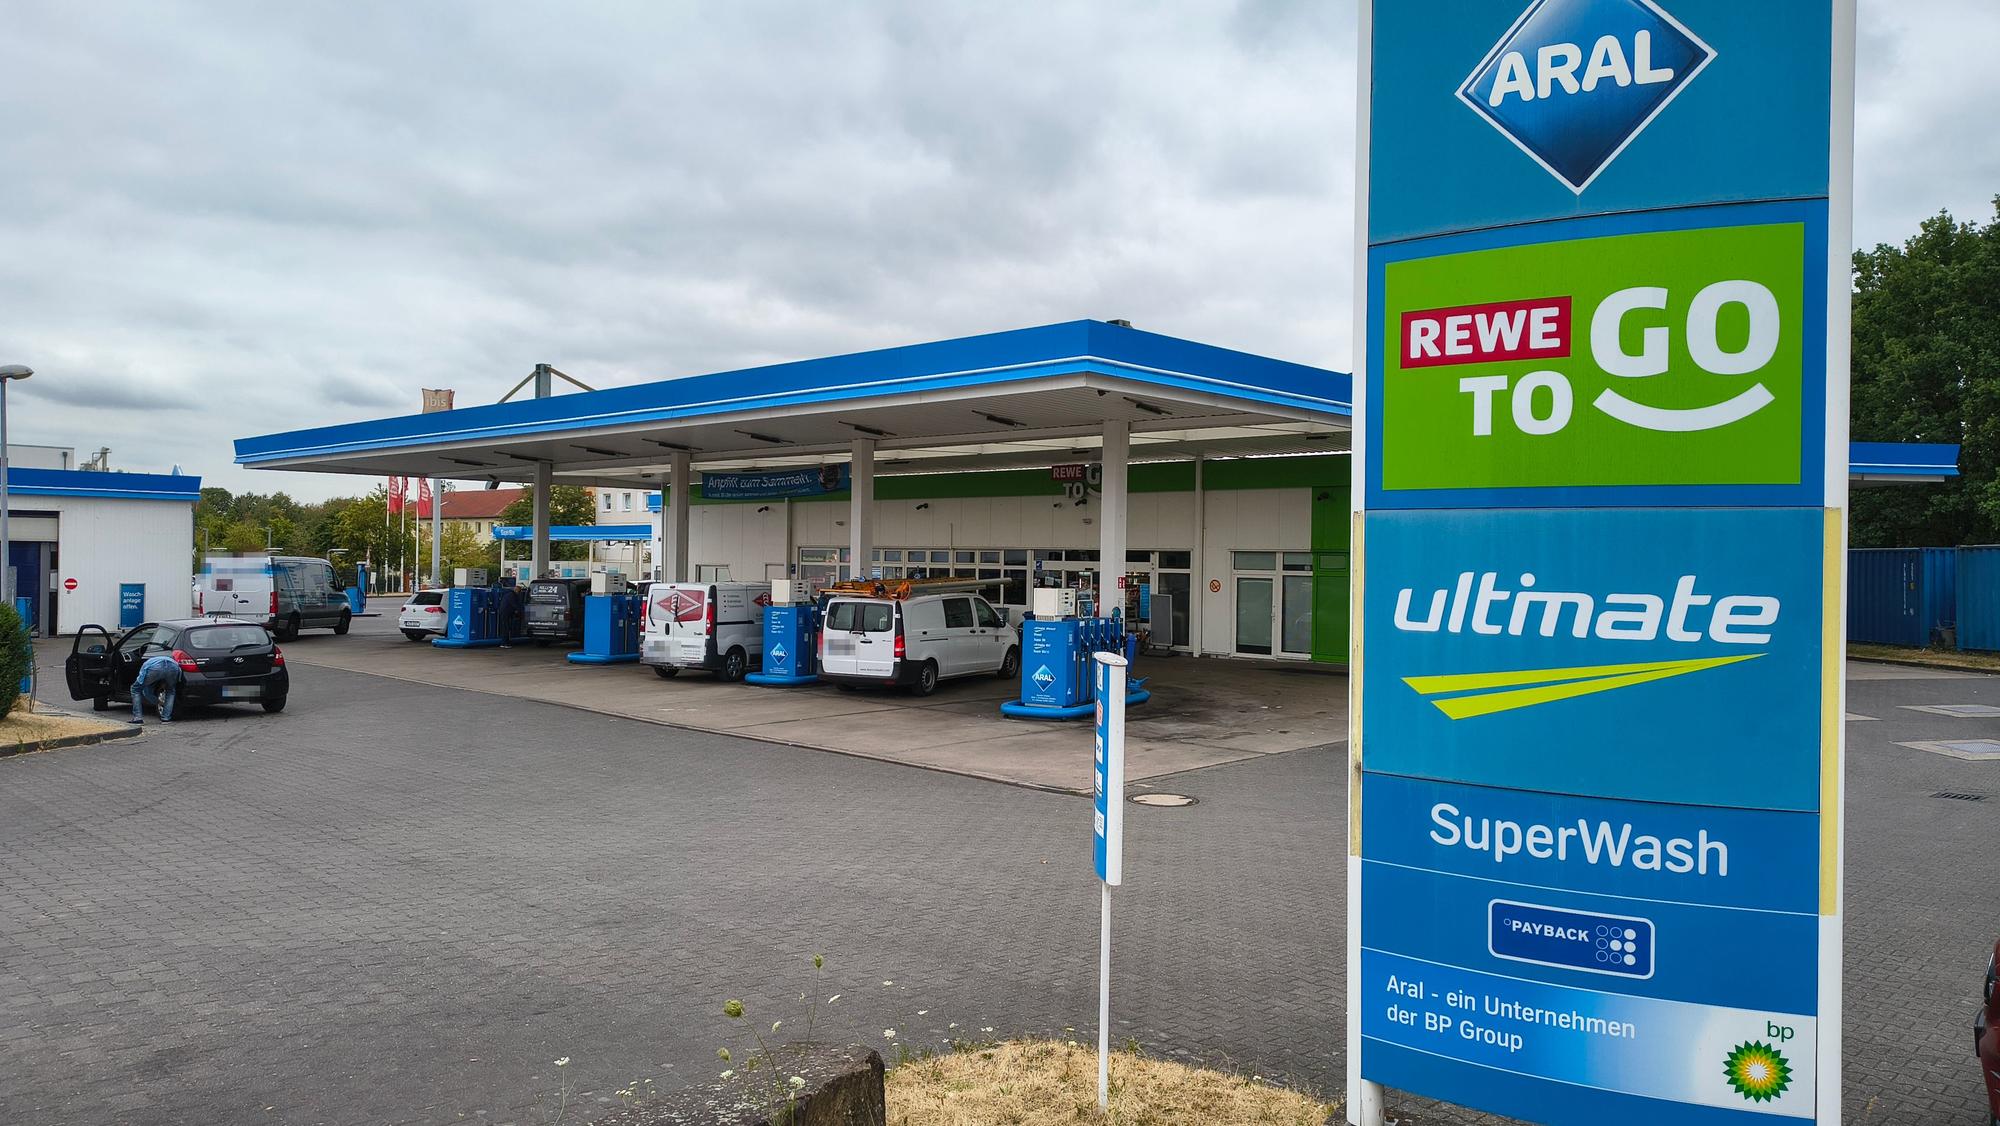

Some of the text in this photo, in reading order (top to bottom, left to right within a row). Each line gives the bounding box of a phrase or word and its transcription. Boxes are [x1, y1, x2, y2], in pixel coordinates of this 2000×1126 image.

[1489, 29, 1675, 107] ARAL
[1410, 306, 1561, 359] REWE
[1590, 280, 1781, 377] GO
[1459, 370, 1574, 436] TO
[740, 479, 760, 488] zum
[1053, 466, 1082, 478] REWE
[1063, 482, 1084, 498] TO
[1086, 463, 1101, 484] G
[1394, 572, 1781, 645] ultimate
[1035, 673, 1053, 682] ARAL
[1430, 803, 1728, 876] SuperWash
[1511, 919, 1589, 942] PAYBACK
[1387, 975, 1424, 1000] Aral
[1446, 990, 1476, 1011] ein
[1485, 995, 1636, 1039] Unternehmen
[1387, 1004, 1523, 1052] der BP Group
[1766, 1020, 1795, 1043] bp
